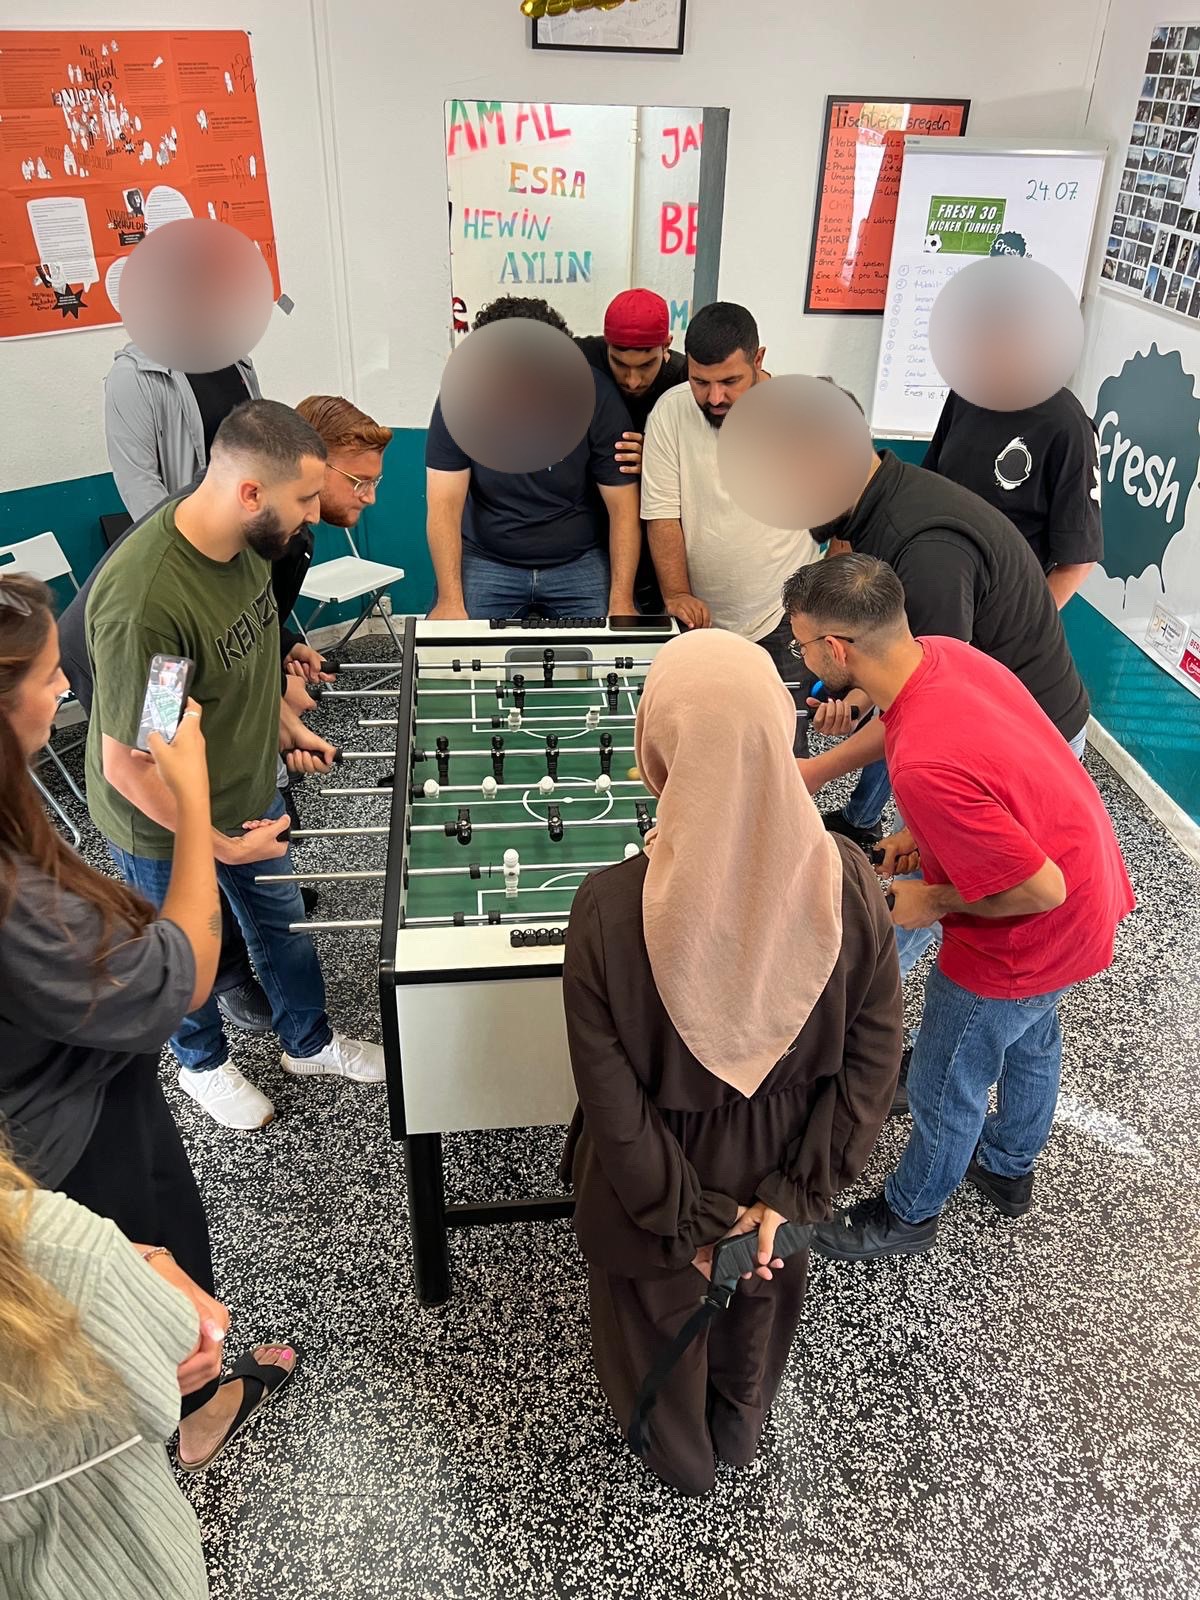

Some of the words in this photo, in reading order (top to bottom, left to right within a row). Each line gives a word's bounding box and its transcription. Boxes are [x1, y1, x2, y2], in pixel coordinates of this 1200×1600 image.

[508, 161, 586, 200] ESRA
[928, 221, 962, 232] KICKER
[963, 222, 1002, 234] TURNIER
[937, 204, 977, 219] FRESH
[979, 206, 997, 220] 30
[498, 251, 592, 284] AYLIN
[1098, 411, 1181, 524] fresh
